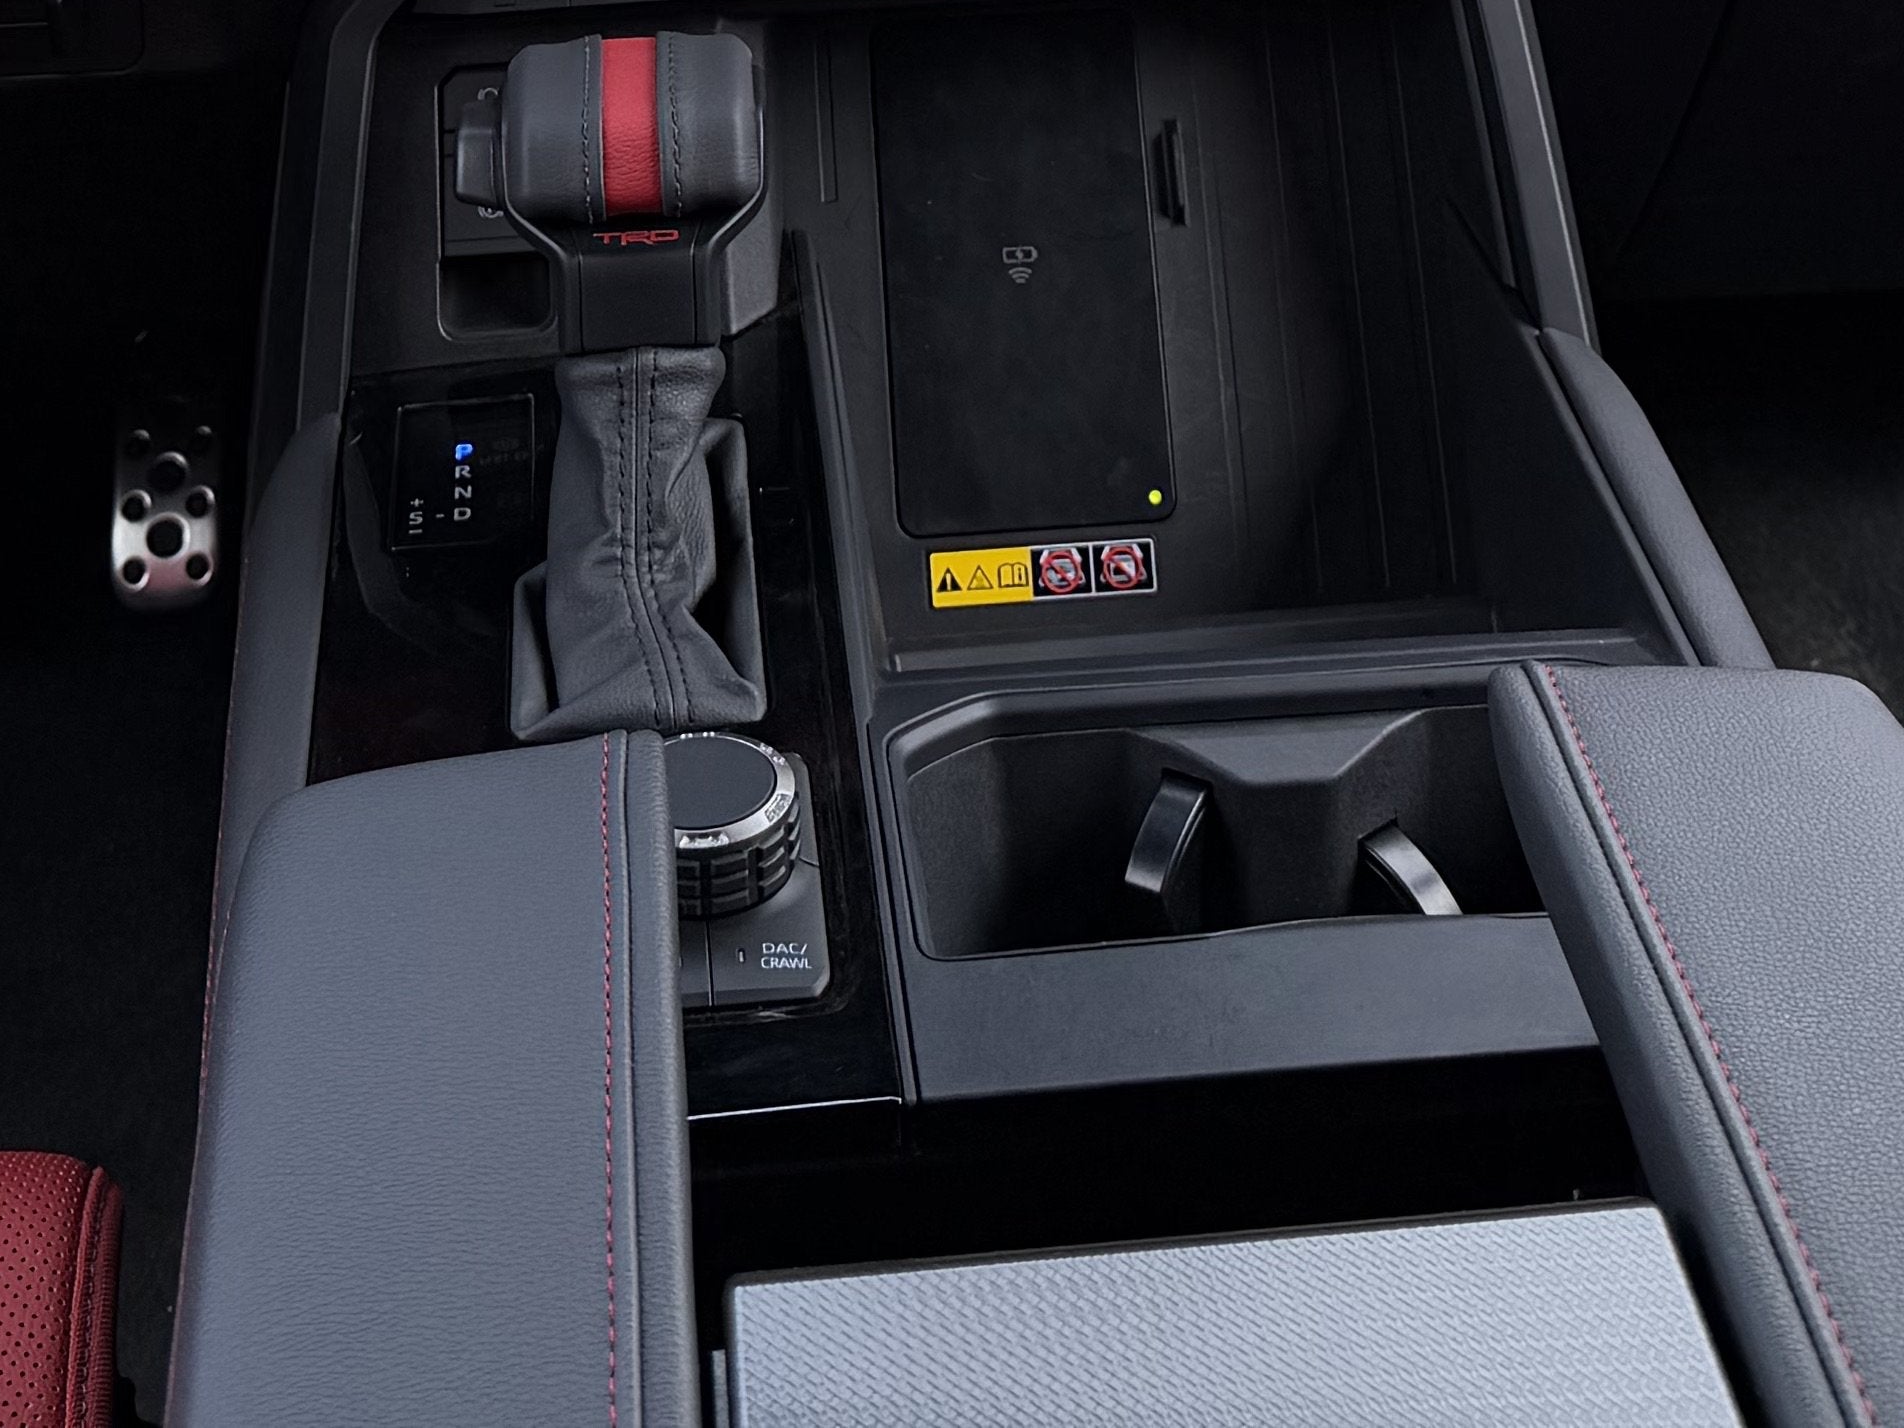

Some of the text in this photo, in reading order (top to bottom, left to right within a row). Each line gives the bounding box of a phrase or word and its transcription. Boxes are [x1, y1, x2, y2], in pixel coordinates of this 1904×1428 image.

[592, 229, 680, 246] TRD
[455, 443, 474, 461] P
[455, 464, 473, 479] R
[454, 485, 473, 500] N
[453, 507, 472, 521] D
[760, 955, 813, 970] CRAWL
